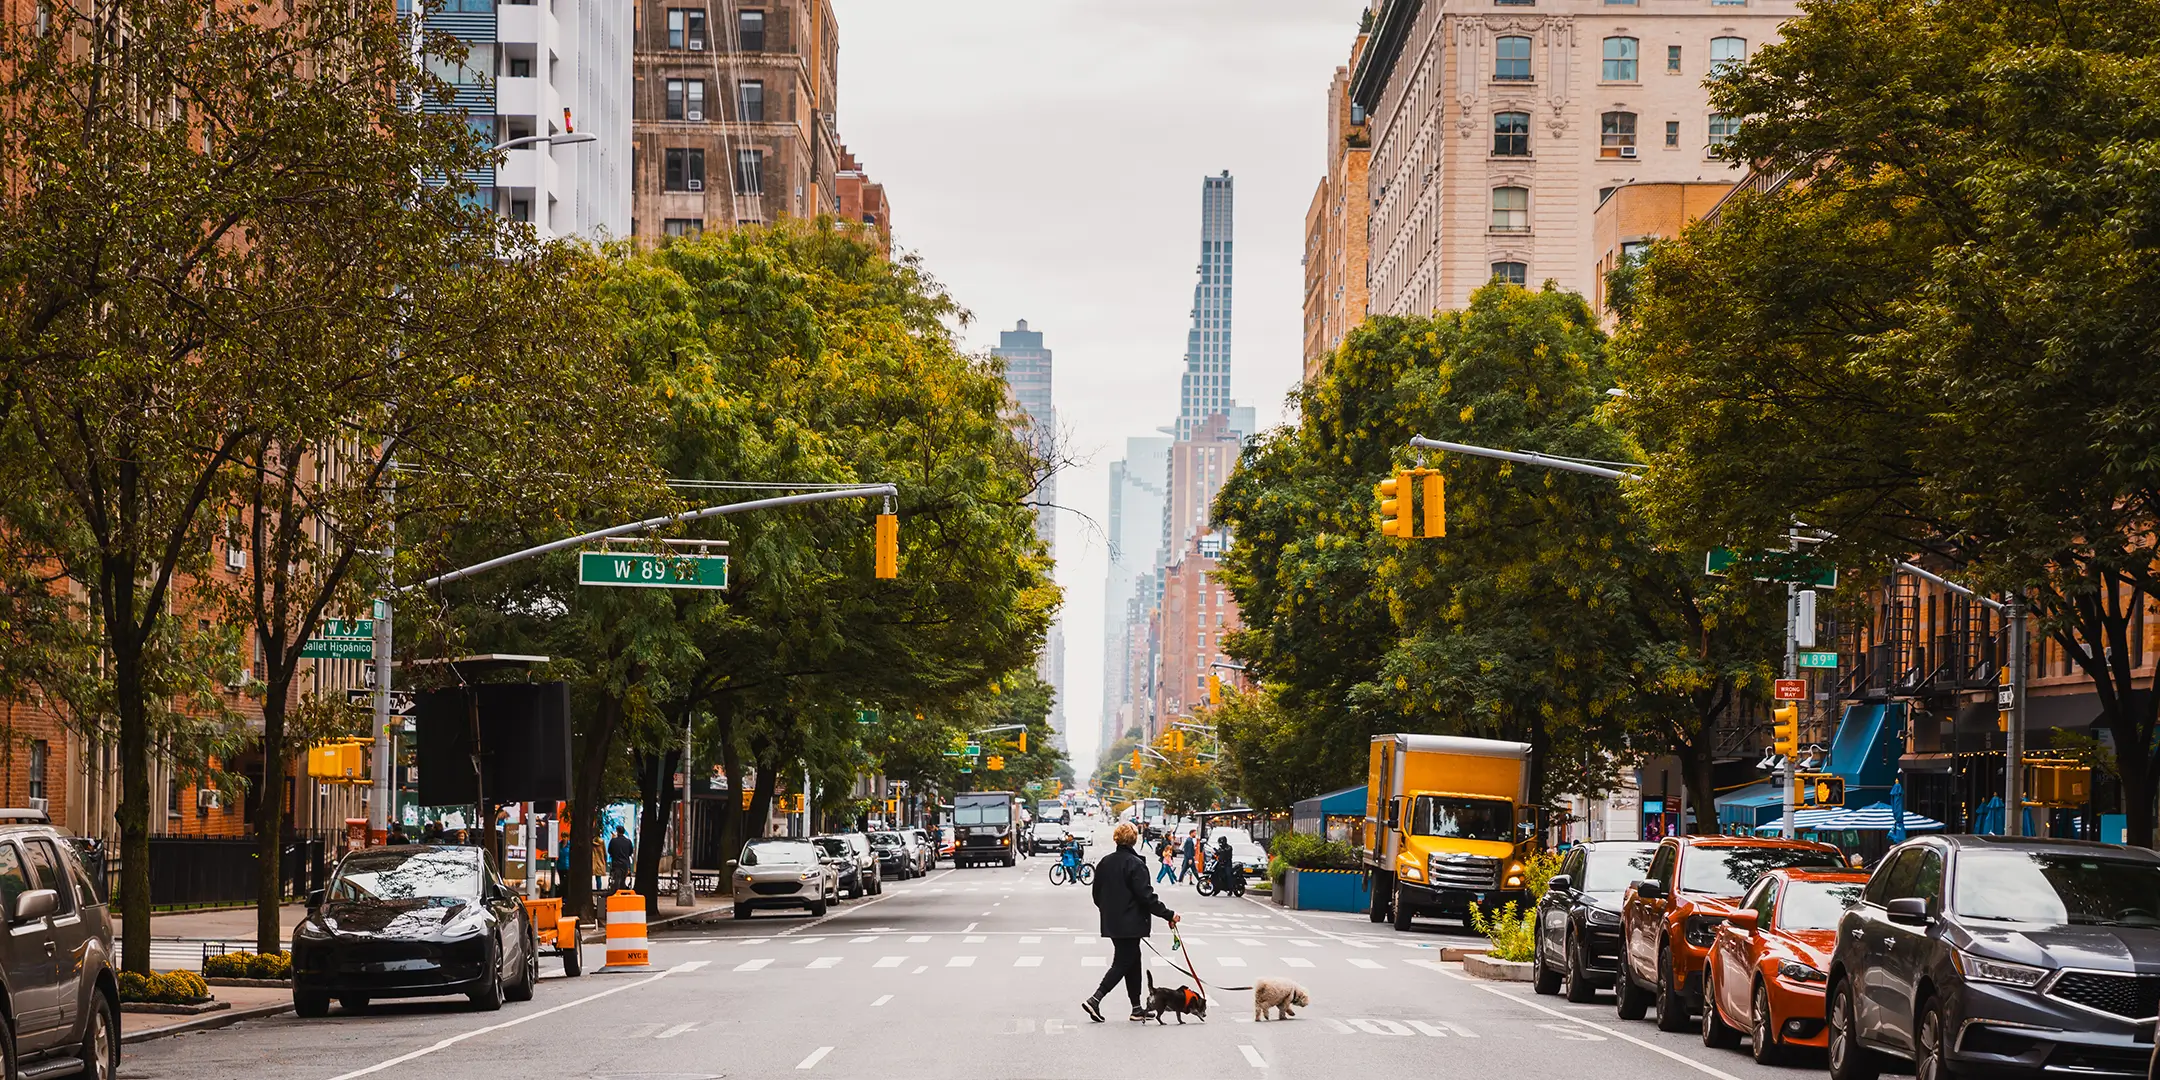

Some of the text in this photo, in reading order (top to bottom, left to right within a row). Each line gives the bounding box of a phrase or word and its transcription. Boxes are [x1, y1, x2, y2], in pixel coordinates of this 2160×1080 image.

[614, 560, 631, 578] W
[641, 560, 665, 579] 89
[328, 621, 338, 635] W
[364, 622, 372, 630] ST
[330, 642, 372, 653] Hispánico
[1800, 655, 1808, 665] W
[1812, 655, 1826, 665] 89
